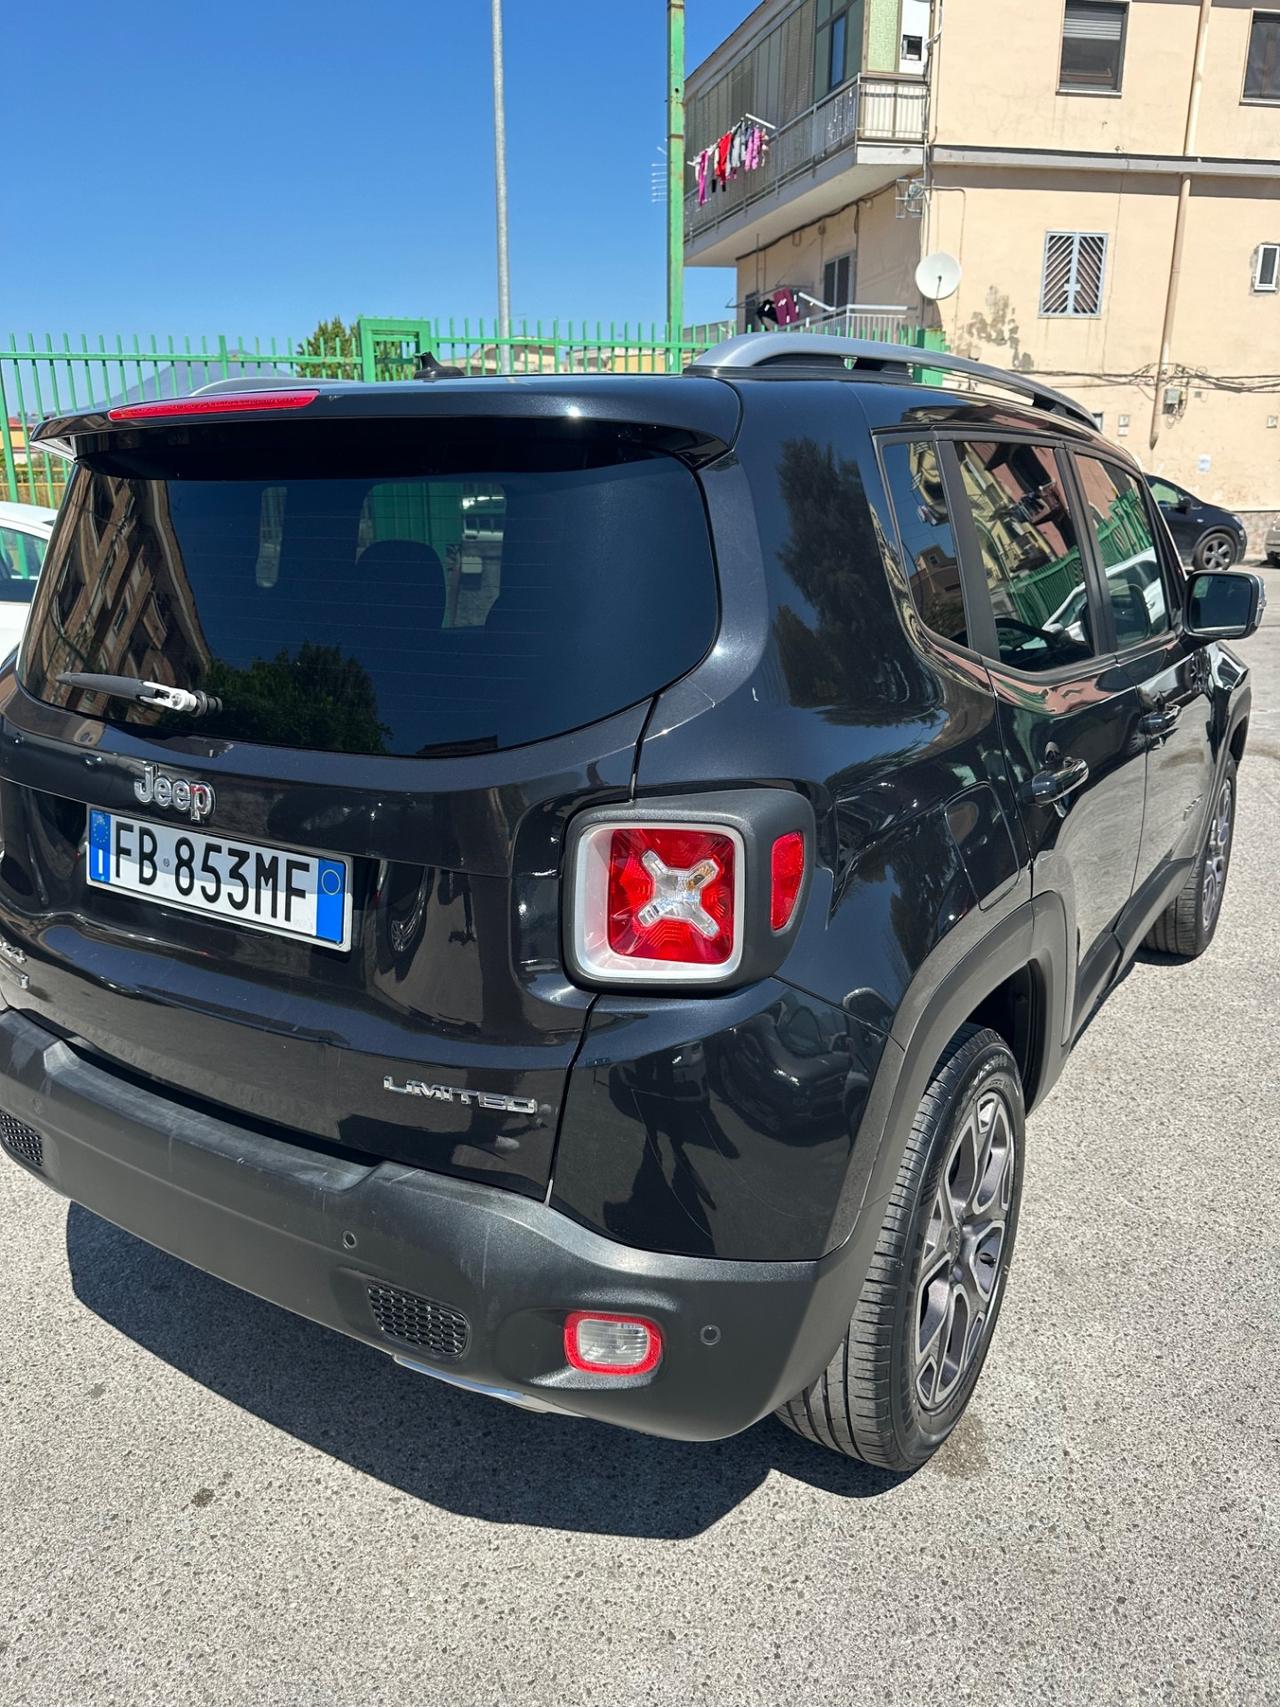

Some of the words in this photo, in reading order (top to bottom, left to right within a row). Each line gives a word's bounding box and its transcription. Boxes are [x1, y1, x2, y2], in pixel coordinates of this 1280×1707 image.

[133, 762, 215, 823] Jeep
[115, 820, 158, 885] FB
[174, 837, 310, 922] 853MF
[383, 1075, 538, 1114] LIMITED
